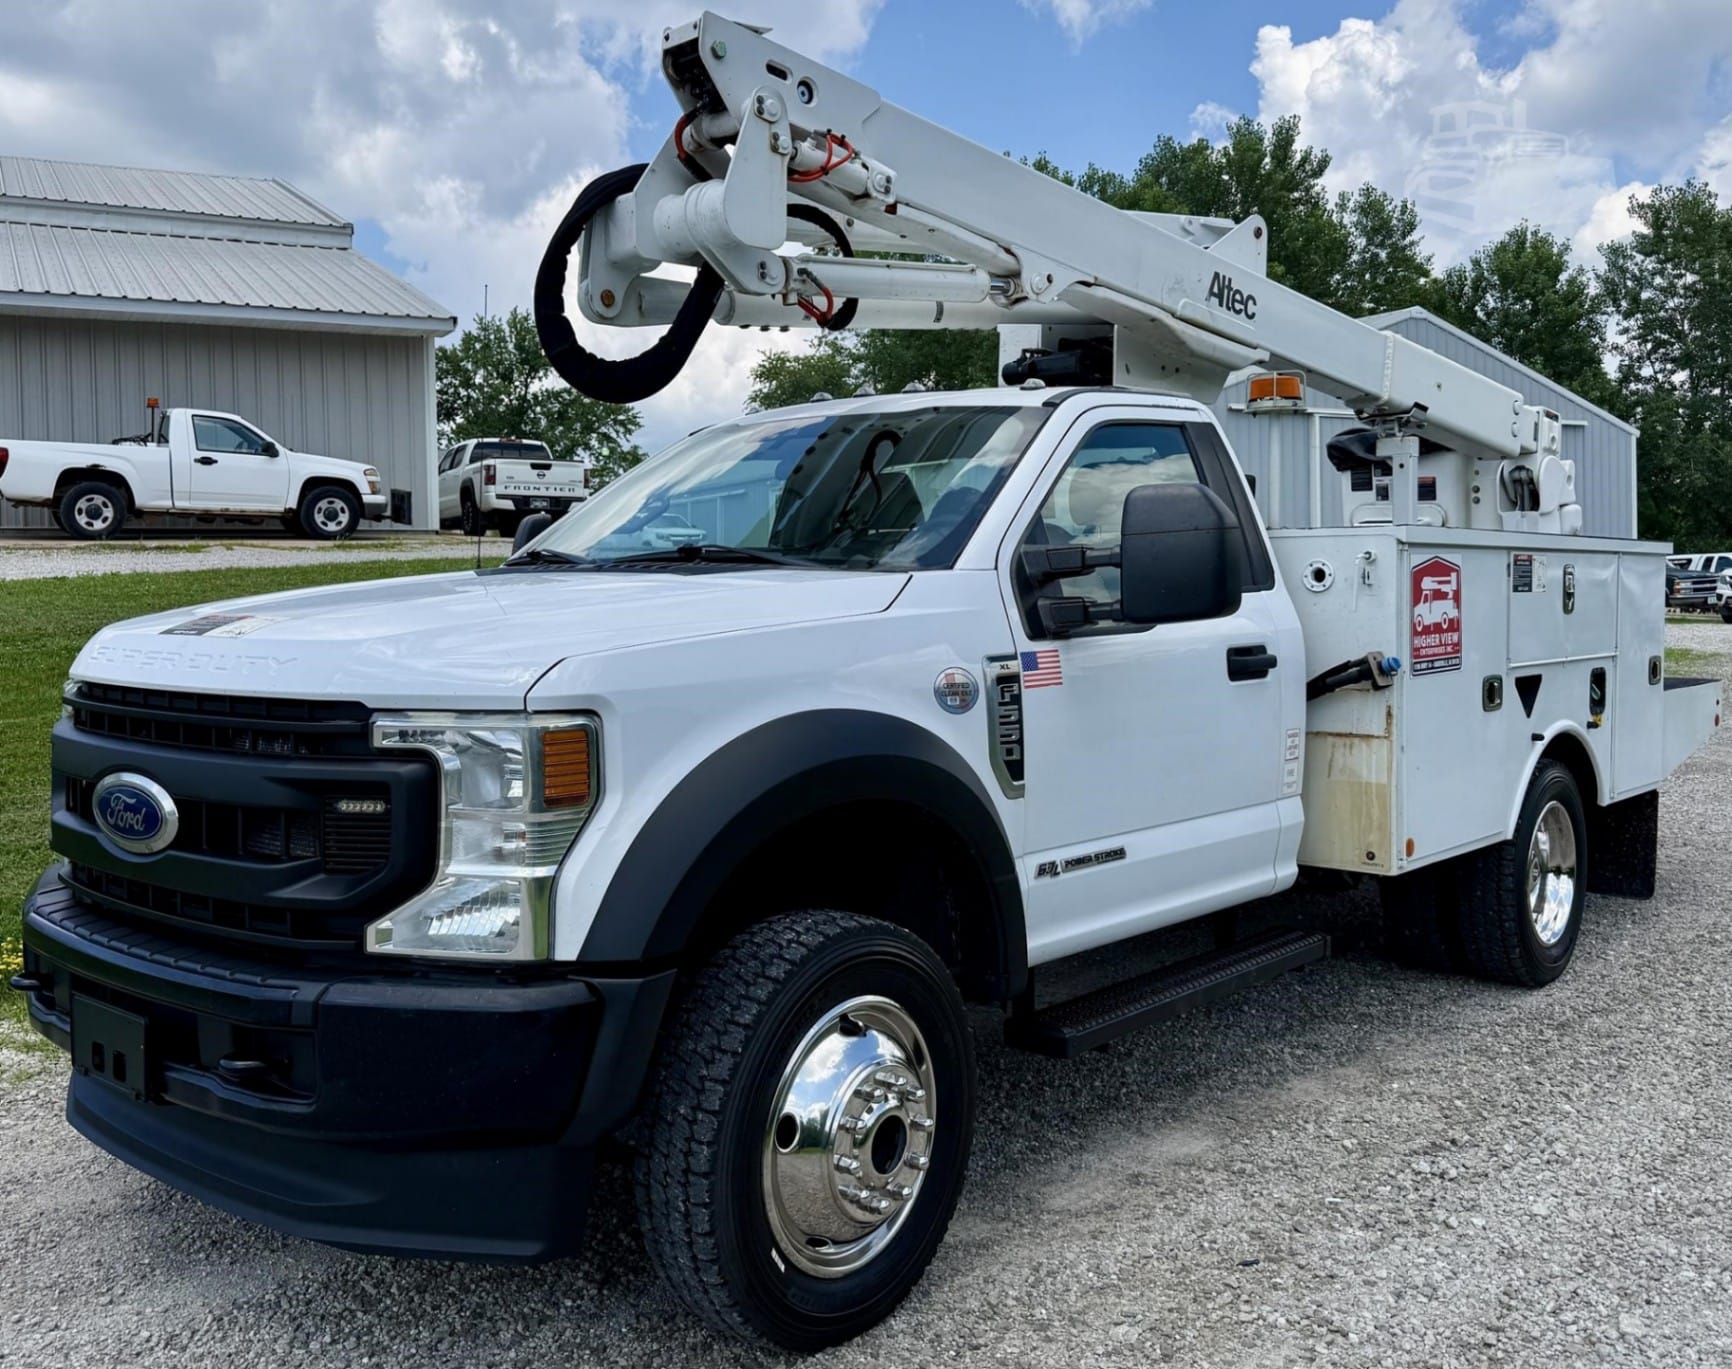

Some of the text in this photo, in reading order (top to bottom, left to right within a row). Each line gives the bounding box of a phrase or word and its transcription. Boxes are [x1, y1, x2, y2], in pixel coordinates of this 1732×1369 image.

[1205, 271, 1257, 320] Altec
[504, 485, 575, 493] FRONTIER
[1413, 631, 1459, 648] HIGHER VIEW
[89, 646, 299, 676] SUPER DUTY
[107, 792, 147, 831] Ford
